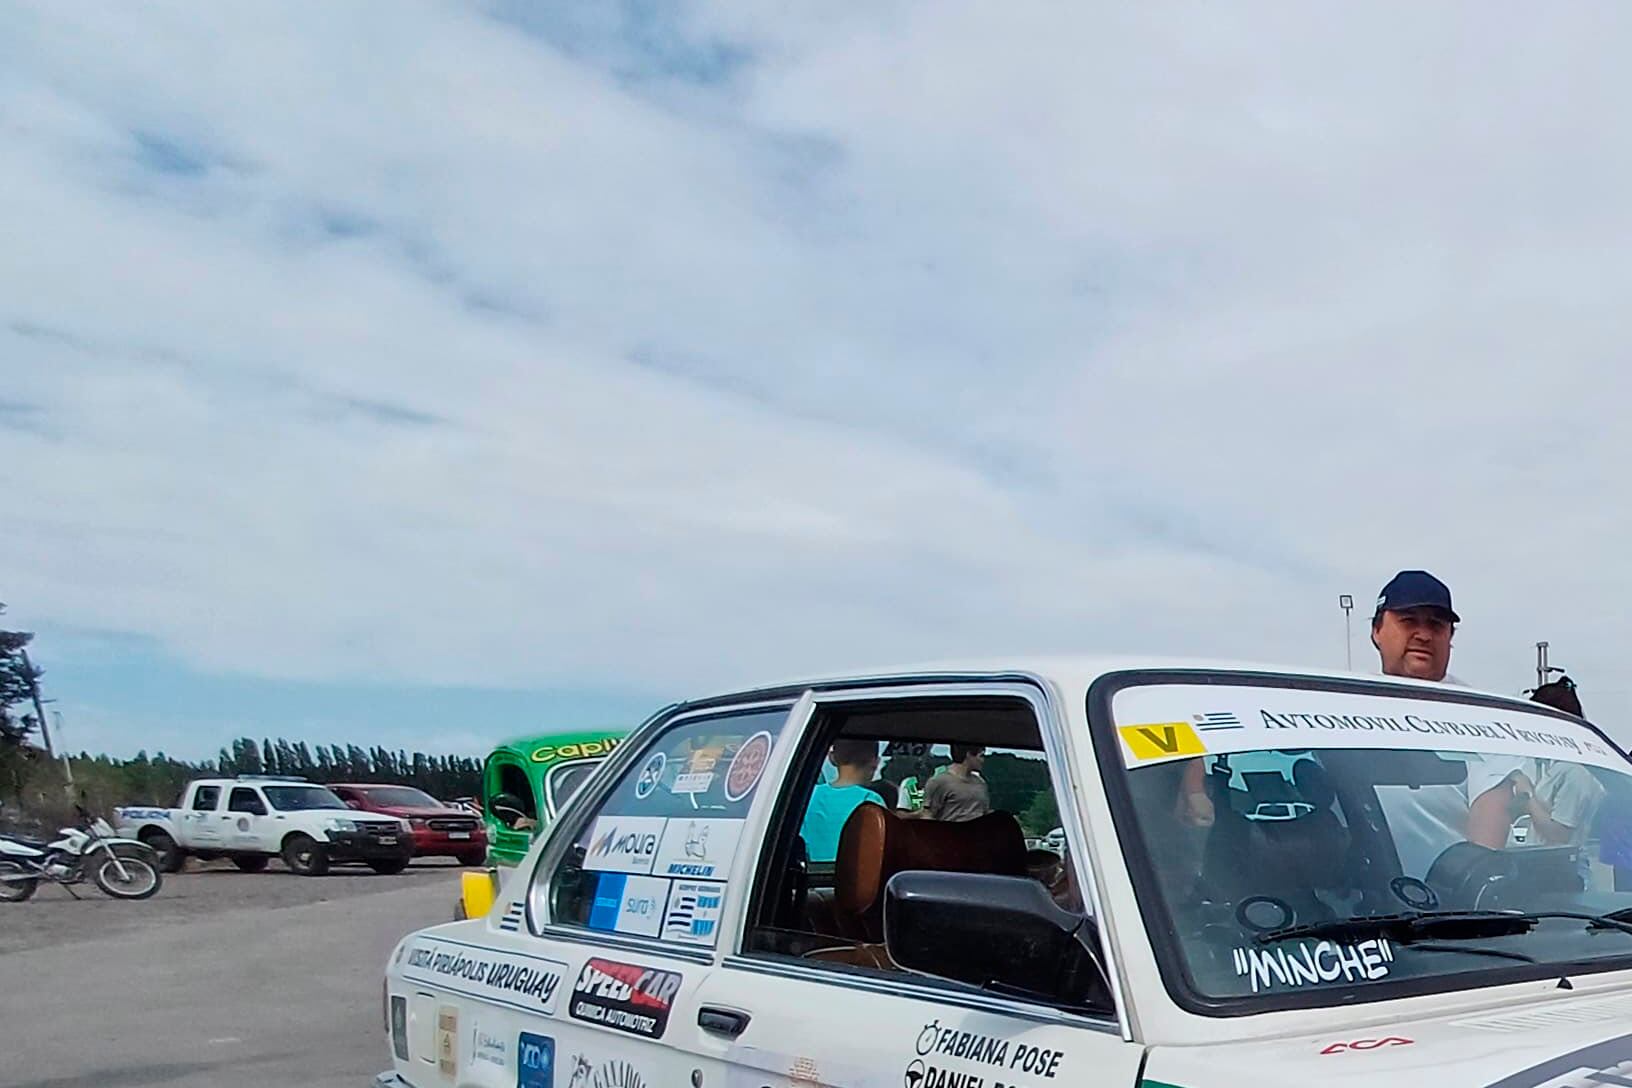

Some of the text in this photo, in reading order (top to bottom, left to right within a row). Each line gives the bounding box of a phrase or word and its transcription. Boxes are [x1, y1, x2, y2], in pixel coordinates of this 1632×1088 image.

[1136, 726, 1179, 753] V
[485, 961, 561, 1004] URUGUAY
[576, 965, 683, 1005] SPEED CAR
[936, 1029, 1064, 1078] FABIANA POSE
